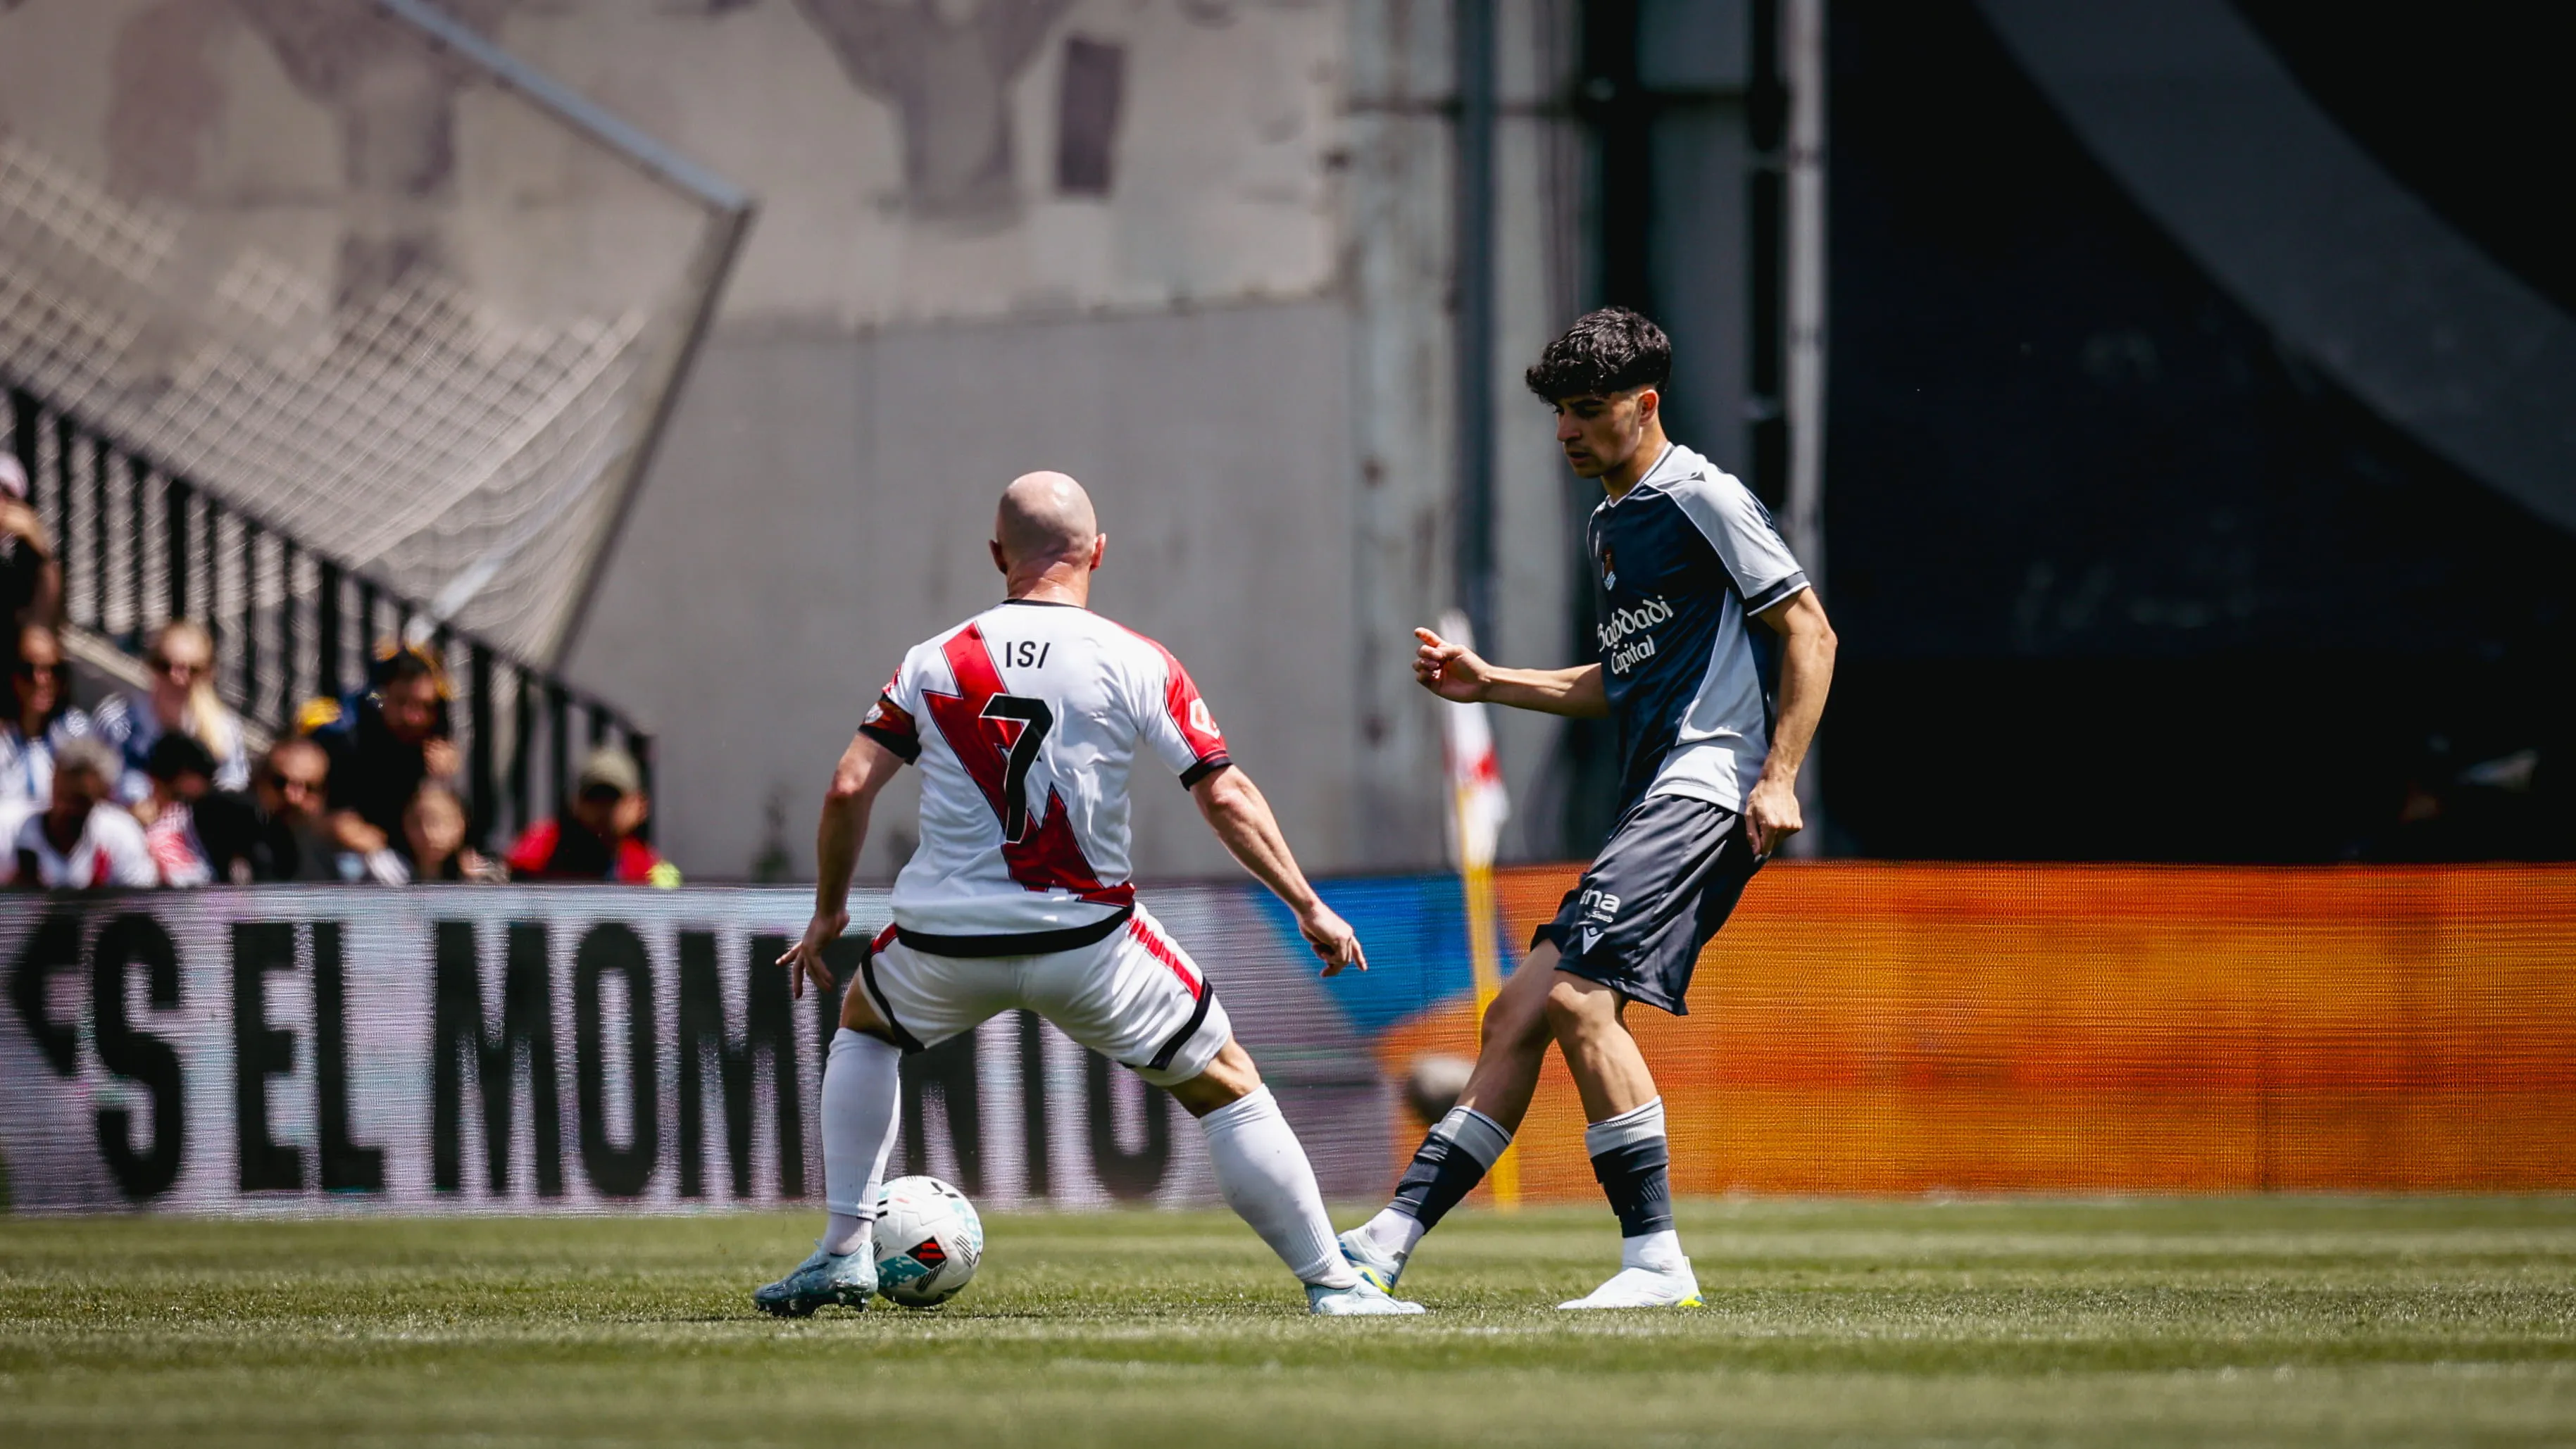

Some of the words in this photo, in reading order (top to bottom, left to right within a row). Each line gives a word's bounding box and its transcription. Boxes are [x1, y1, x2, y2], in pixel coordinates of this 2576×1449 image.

[1005, 641, 1051, 669] ISI
[1611, 634, 1656, 675] Capital
[978, 692, 1054, 844] 7
[231, 920, 386, 1191] EL
